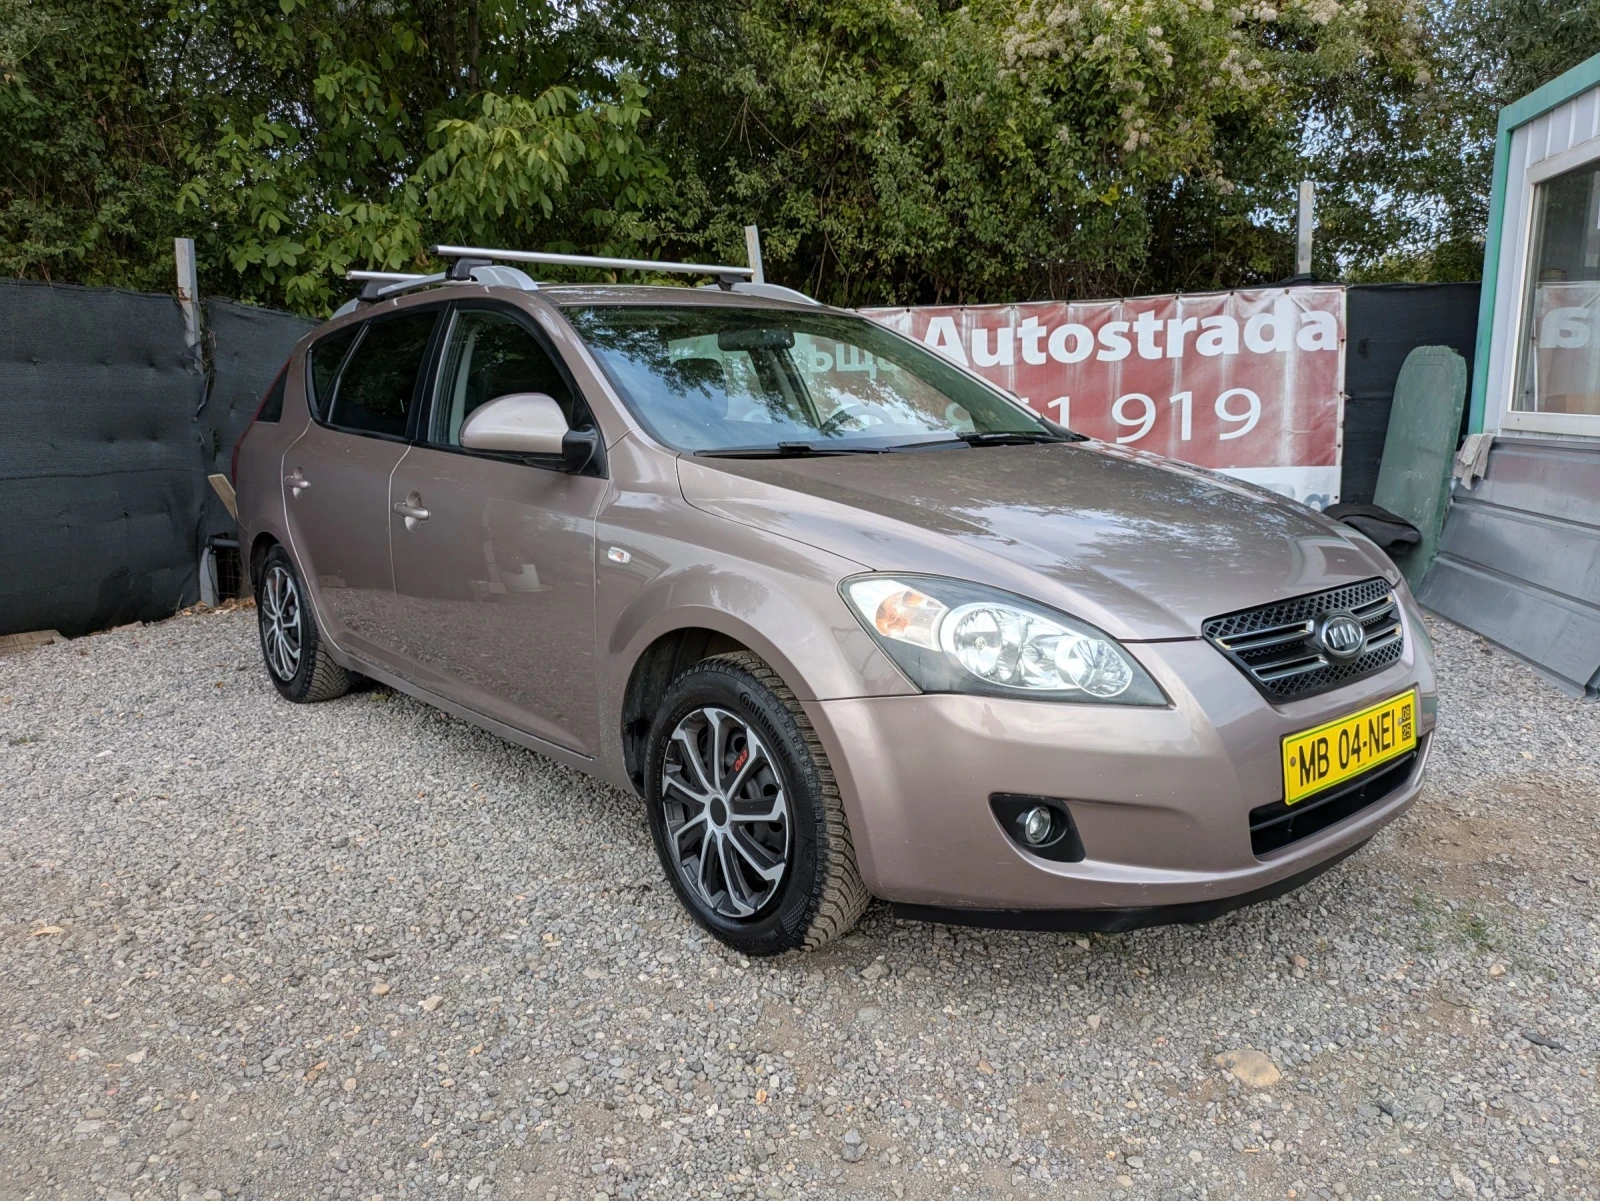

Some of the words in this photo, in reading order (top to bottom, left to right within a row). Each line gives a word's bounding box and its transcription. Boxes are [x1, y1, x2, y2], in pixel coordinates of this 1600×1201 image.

[923, 303, 1338, 367] Autostrada
[1111, 387, 1262, 444] 919
[739, 691, 793, 760] Continental
[1298, 737, 1330, 788] MB
[1338, 708, 1395, 771] 04-NEI
[1401, 724, 1412, 740] 25
